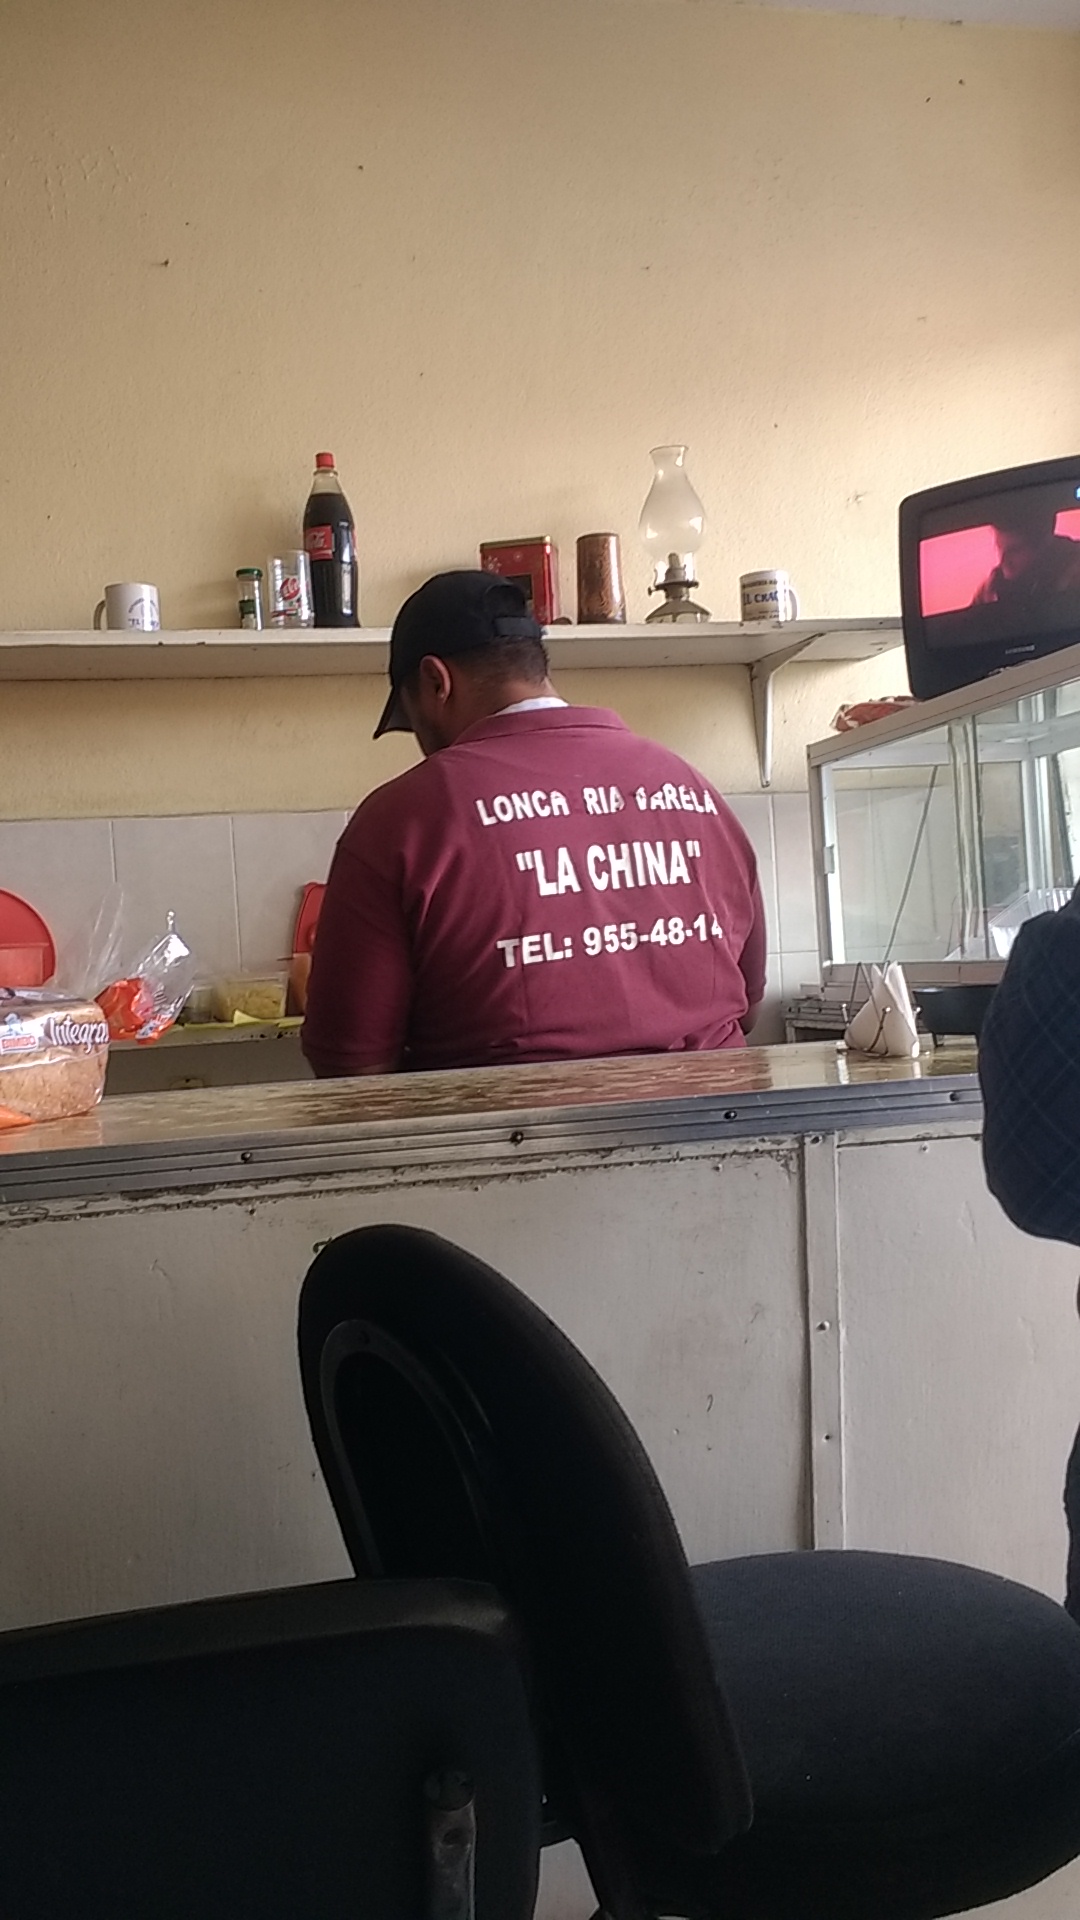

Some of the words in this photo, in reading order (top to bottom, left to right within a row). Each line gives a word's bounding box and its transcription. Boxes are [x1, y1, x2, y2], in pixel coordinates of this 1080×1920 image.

[635, 782, 720, 816] VARELA
[516, 847, 581, 896] "LA
[586, 840, 701, 891] CHINA"
[497, 933, 572, 968] TEL:
[582, 913, 723, 956] 955-48-14
